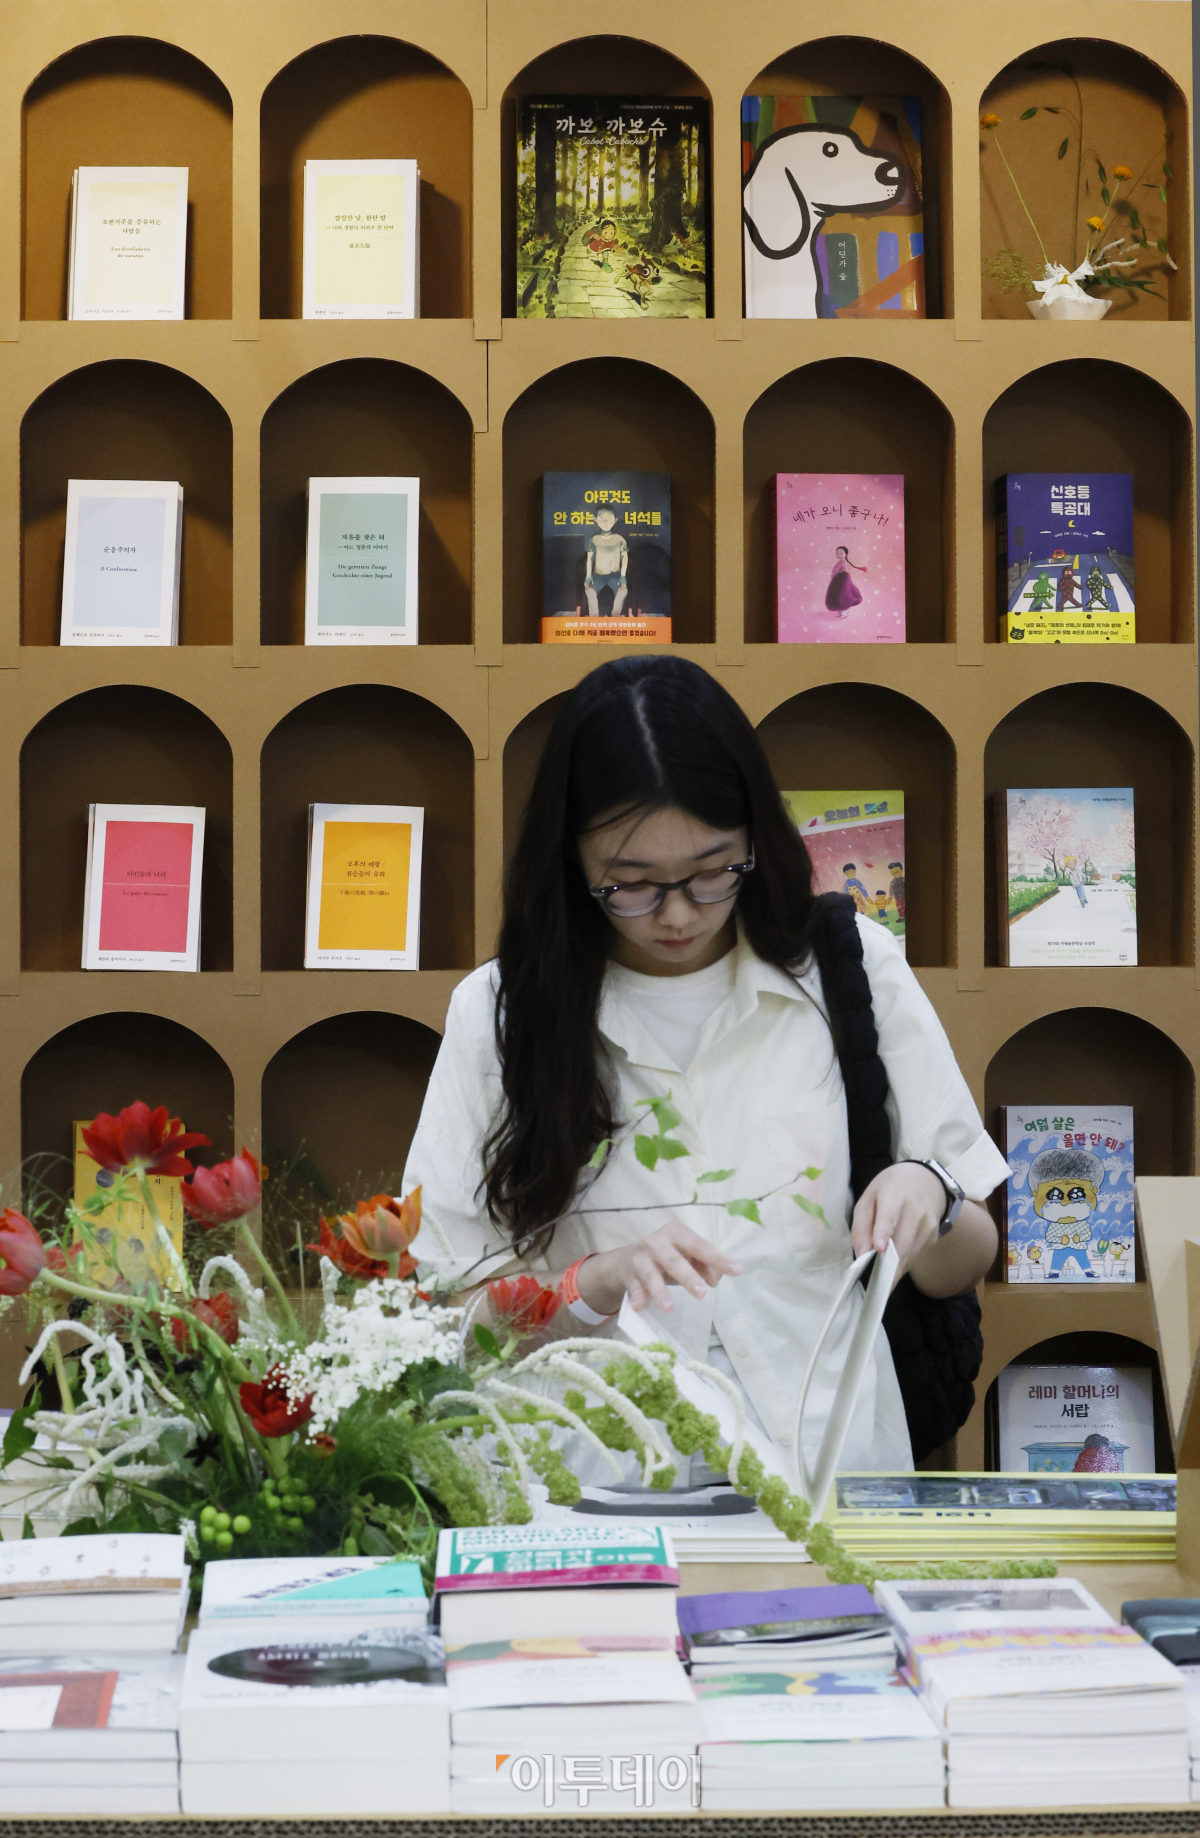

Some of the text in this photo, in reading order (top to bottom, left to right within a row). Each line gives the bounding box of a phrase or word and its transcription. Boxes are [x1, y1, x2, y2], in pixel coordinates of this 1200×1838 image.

[556, 116, 668, 137] 까보 까보슈
[838, 241, 847, 281] 어딘가 숲
[584, 490, 631, 504] 아무것도
[1051, 485, 1090, 499] 신호등
[793, 504, 889, 526] 네가 오니 좋구나!
[1051, 502, 1091, 516] 특공대
[554, 511, 662, 525] 안 하는 녀석들
[1024, 1117, 1075, 1132] 여덟 살은
[1063, 1133, 1125, 1153] 울면 안 돼?
[1028, 1384, 1120, 1399] 레미 할머니의
[1061, 1404, 1090, 1418] 서랍
